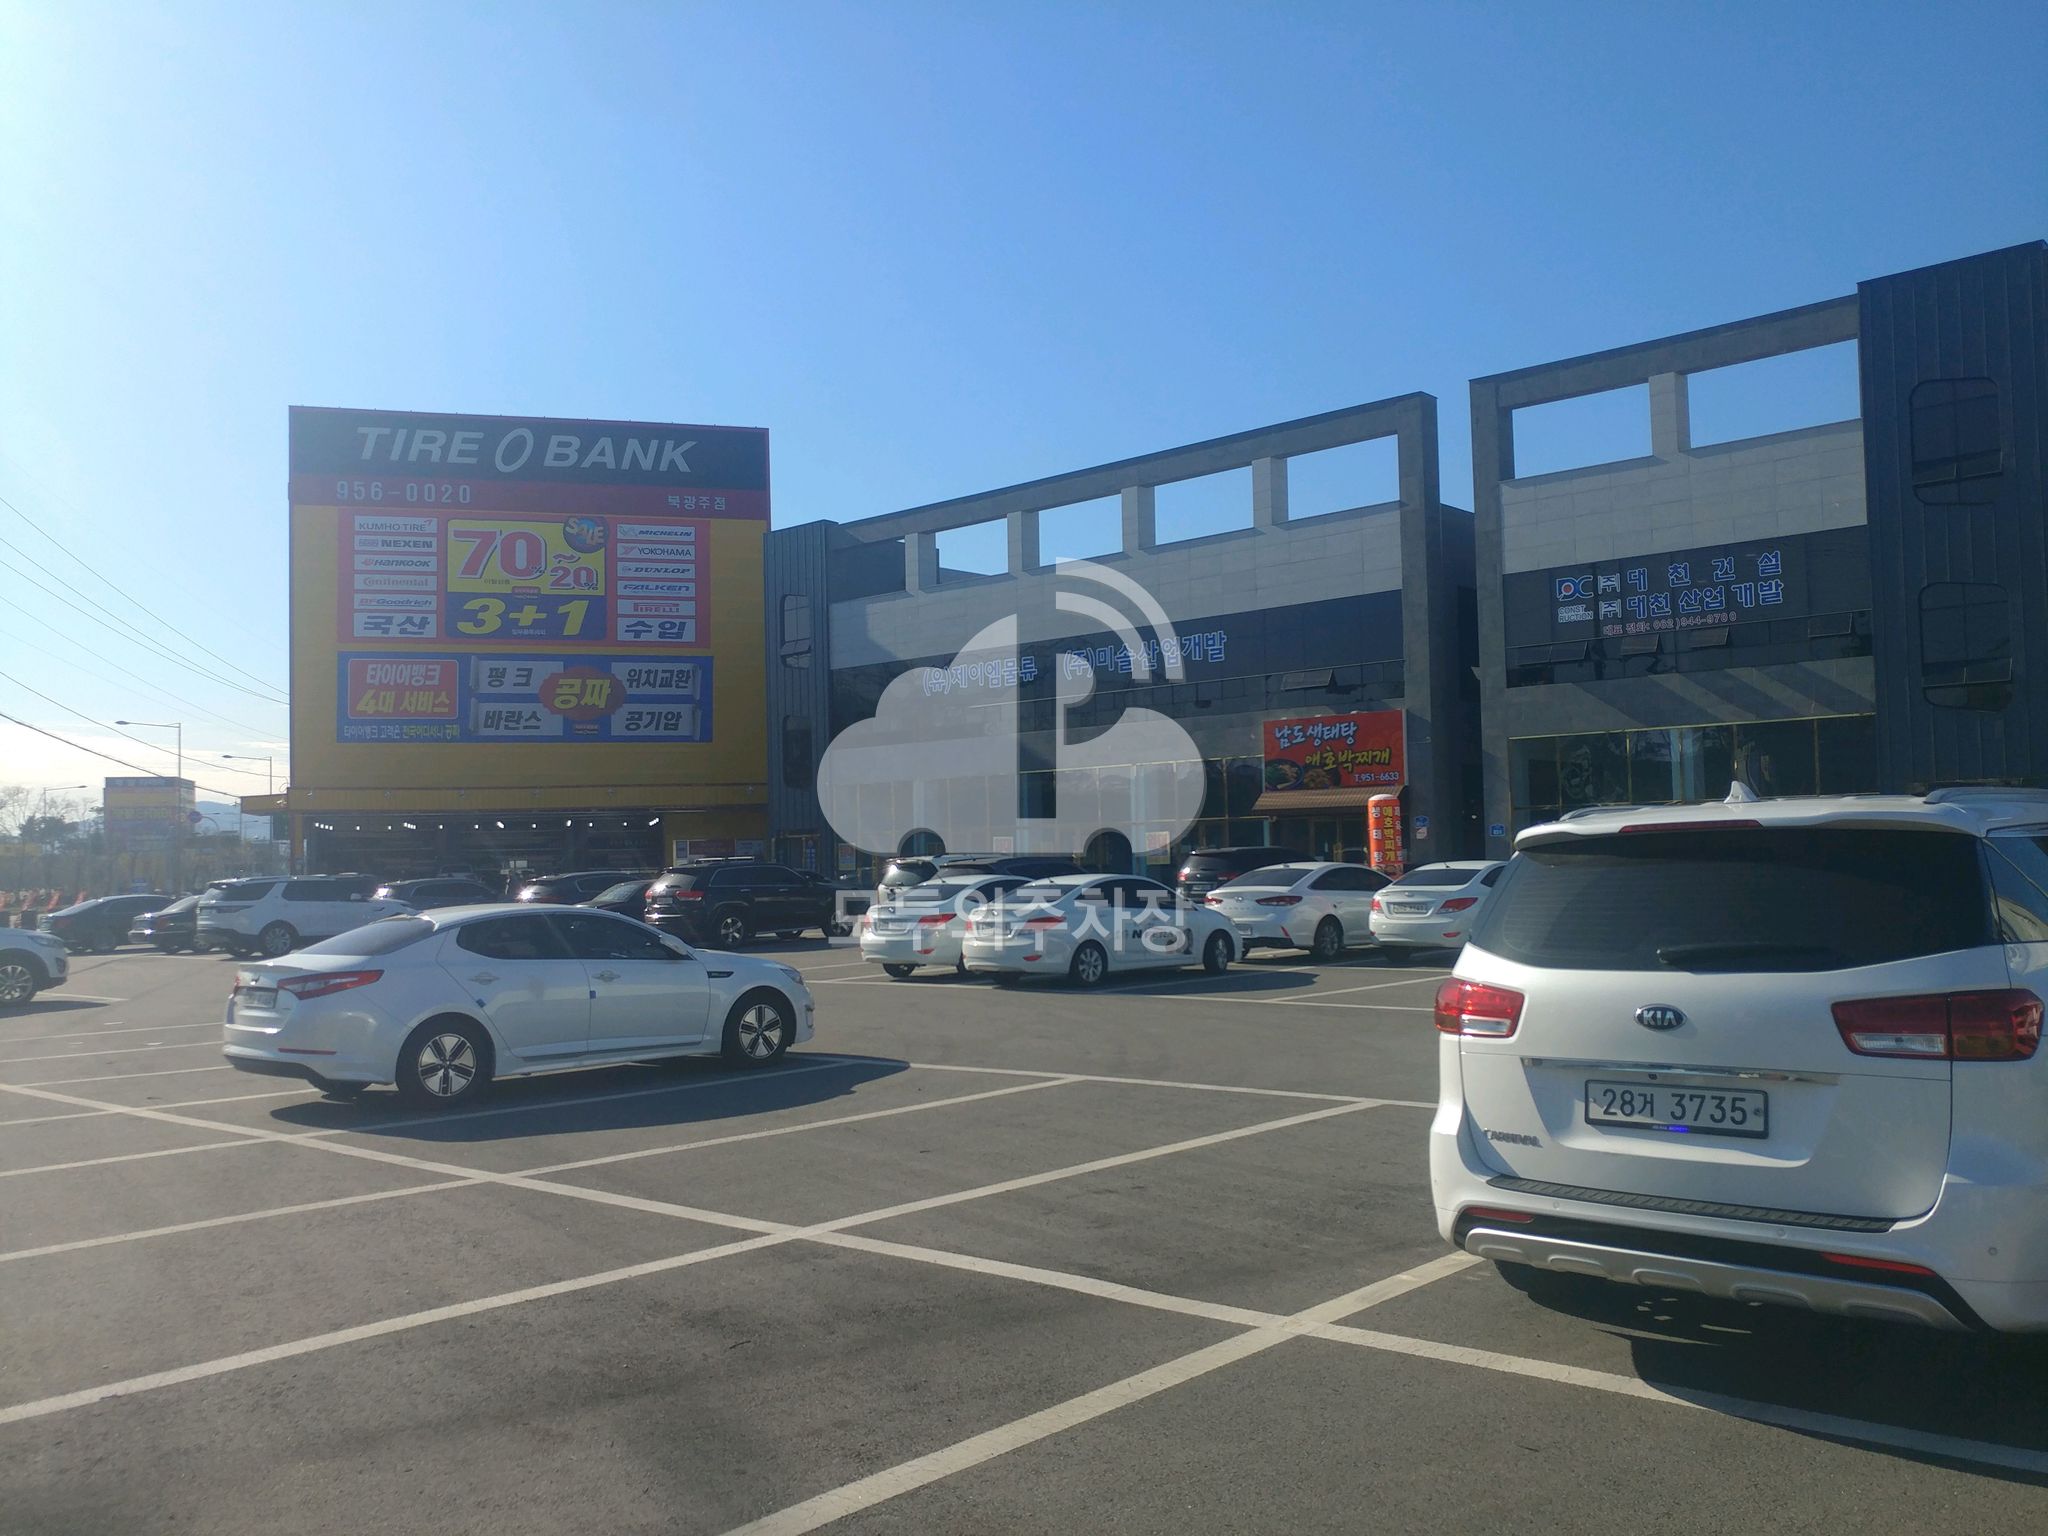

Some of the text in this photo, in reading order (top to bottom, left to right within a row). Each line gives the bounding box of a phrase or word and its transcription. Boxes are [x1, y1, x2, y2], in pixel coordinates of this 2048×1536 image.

[356, 426, 484, 465] TIRE
[543, 434, 698, 473] BANK
[336, 480, 472, 504] 956-0020
[667, 495, 726, 511] 북광주점
[358, 522, 400, 530] KUMHO
[381, 540, 432, 548] NEXEN
[637, 548, 692, 556] YOKOHAMA
[363, 577, 429, 587] Continental
[633, 602, 680, 612] PIRELLI
[363, 615, 431, 635] 국산
[624, 620, 687, 639] 수입
[366, 664, 441, 687] 타이어뱅크
[626, 669, 692, 690] 위치교환
[356, 689, 450, 714] 4대 서비스
[553, 678, 611, 710] 공짜
[483, 710, 543, 731] 바란스
[624, 711, 683, 732] 공기압
[1275, 722, 1357, 749] 남도 생태탕
[1642, 1010, 1677, 1025] KIA
[1670, 1094, 1748, 1126] 3735
